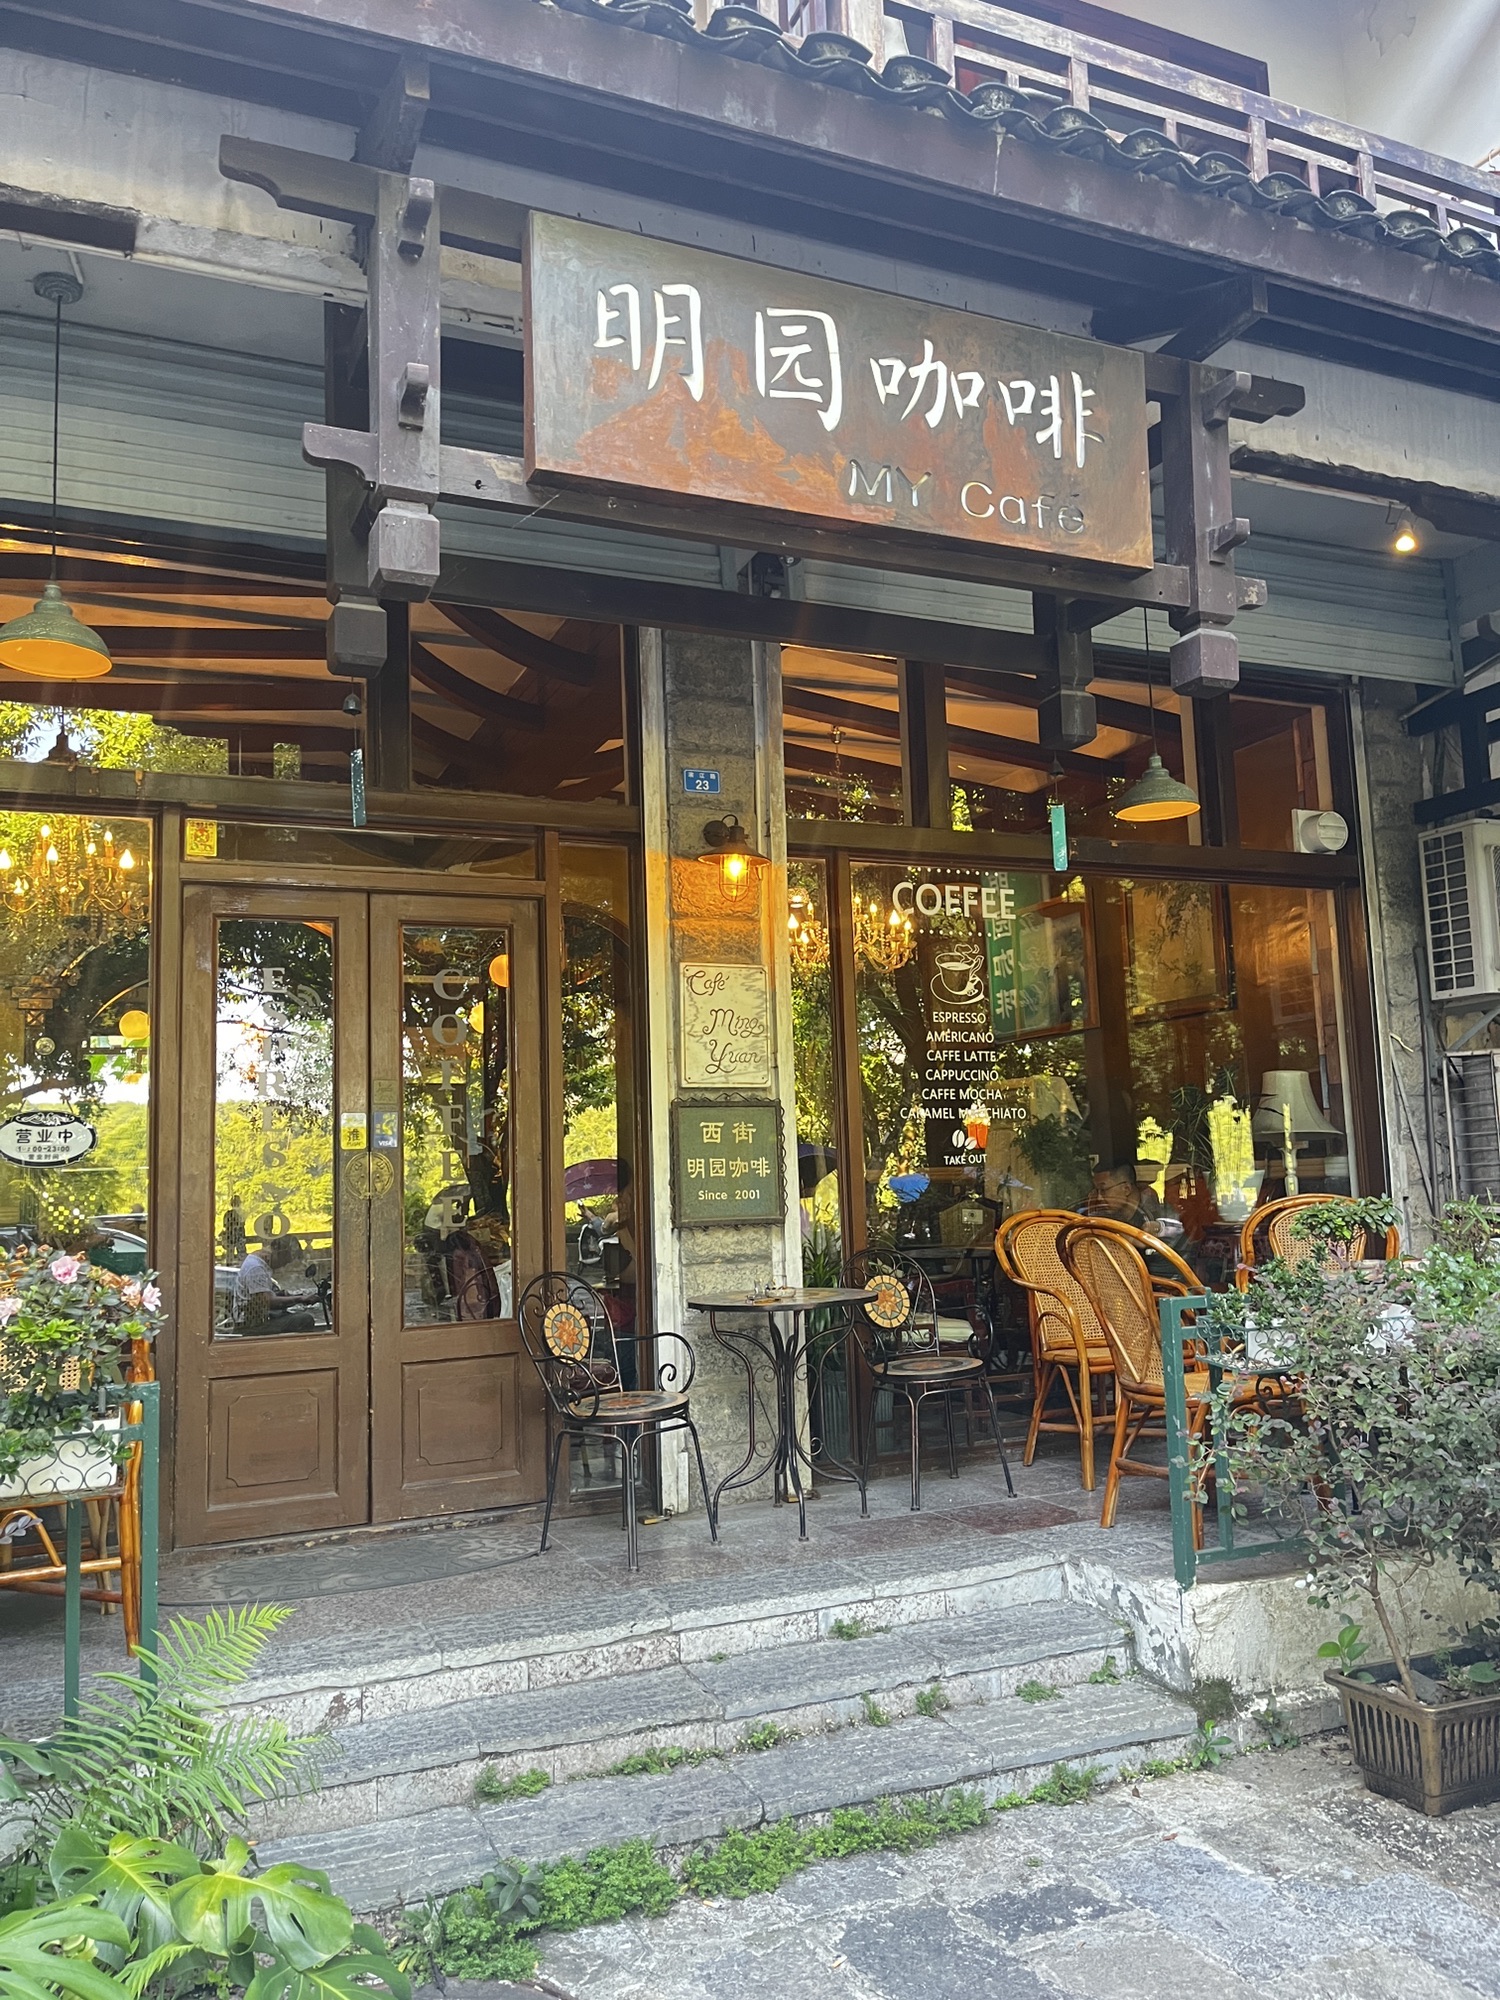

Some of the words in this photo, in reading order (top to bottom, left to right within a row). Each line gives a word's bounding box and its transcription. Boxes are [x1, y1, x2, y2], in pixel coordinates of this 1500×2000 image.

[594, 282, 1104, 468] 明园咖啡
[848, 458, 932, 507] MY
[960, 481, 1085, 534] Café
[695, 779, 710, 791] 23
[892, 881, 1016, 920] COFFEE
[686, 970, 730, 996] Café
[702, 1008, 765, 1038] Ming
[932, 1011, 986, 1024] ESPRESSO
[926, 1031, 994, 1044] AMERICANO
[705, 1039, 762, 1074] Yuan
[926, 1050, 961, 1062] CAFFE
[963, 1050, 997, 1062] LATTE
[925, 1069, 999, 1081] CAPPUCCINO
[431, 968, 468, 1229] COFFEE
[921, 1088, 956, 1100] CAFFE
[959, 1089, 1002, 1100] MOCHA
[958, 1107, 1027, 1119] MCHIATO
[15, 1128, 74, 1143] 营业中
[346, 1128, 360, 1142] 推
[699, 1121, 757, 1144] 西街
[943, 1155, 966, 1165] TAKE
[968, 1154, 988, 1164] OUT
[686, 1156, 772, 1179] 明园咖啡
[698, 1190, 728, 1200] Since
[735, 1189, 760, 1200] 2001
